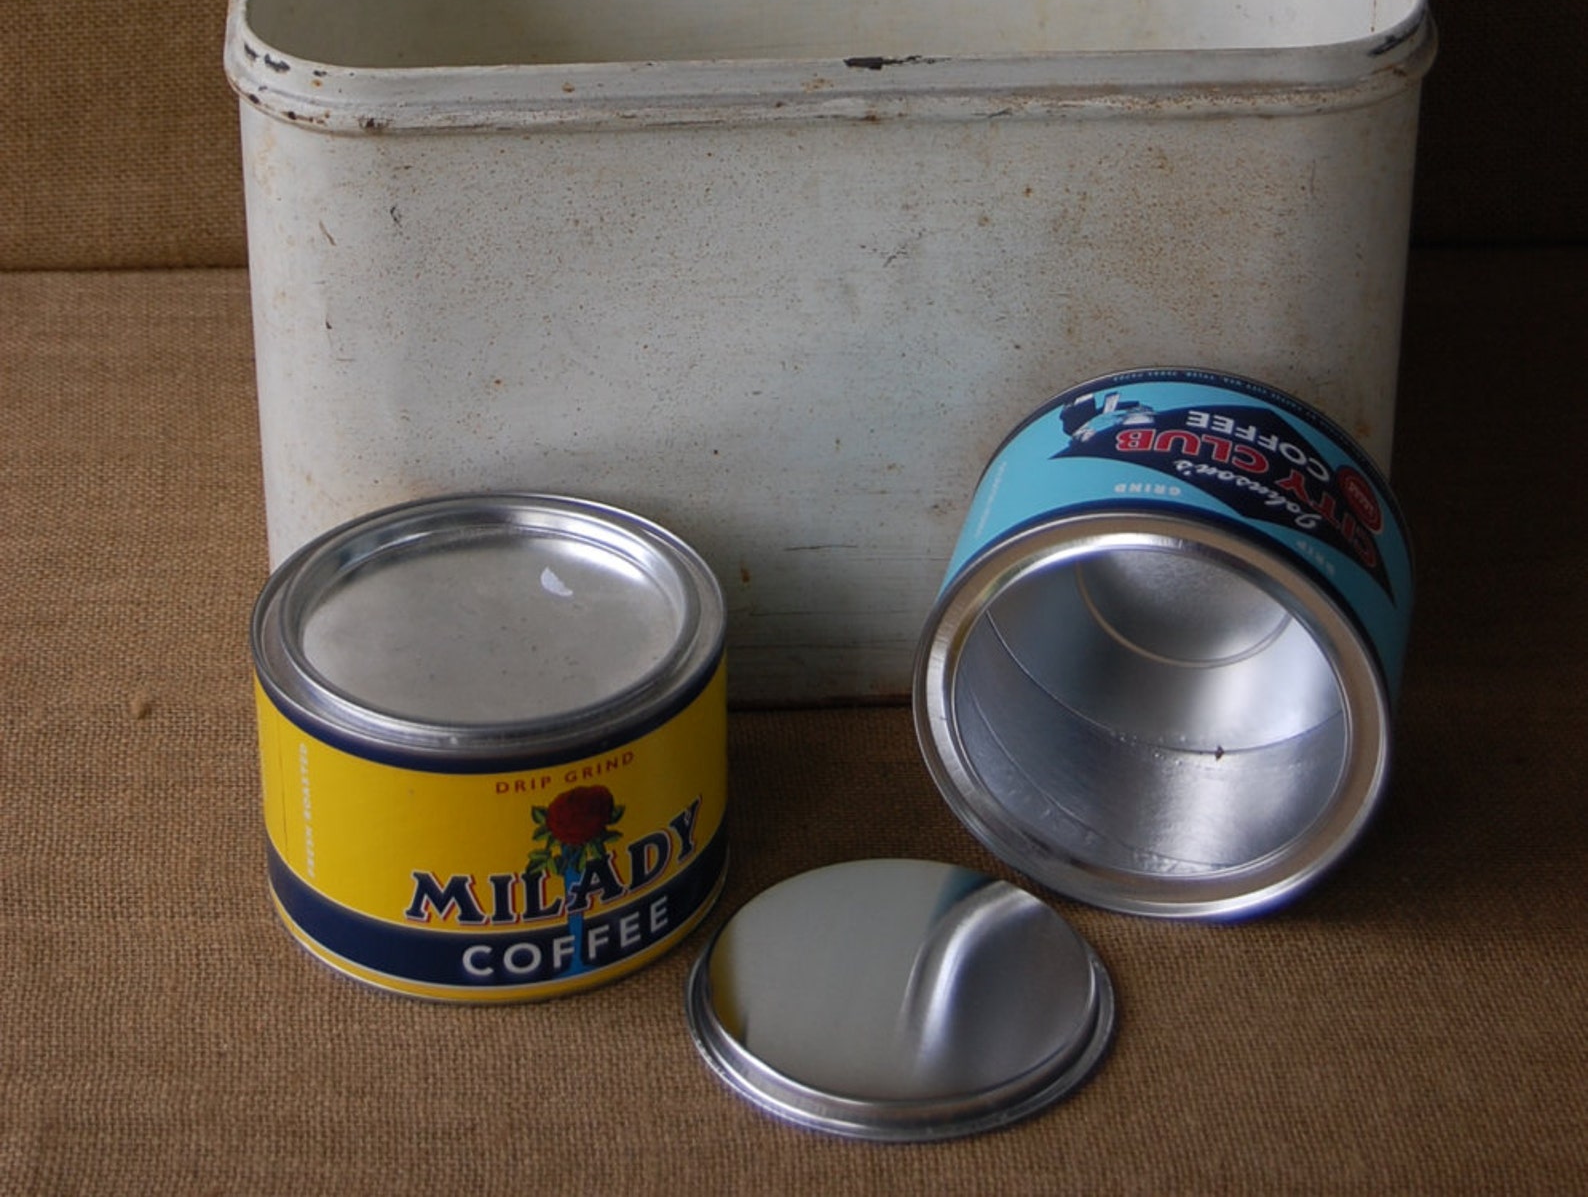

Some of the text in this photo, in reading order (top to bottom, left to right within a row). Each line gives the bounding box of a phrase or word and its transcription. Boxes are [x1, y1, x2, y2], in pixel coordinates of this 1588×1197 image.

[1115, 428, 1270, 474] CLUB
[1185, 409, 1330, 482] COFFEE
[1113, 482, 1182, 497] GRIND
[1173, 459, 1323, 530] Johnson's
[1279, 469, 1378, 569] CITY
[495, 751, 636, 795] DRIP GRIND
[404, 794, 704, 926] MILADY
[462, 896, 670, 976] COFFEE
